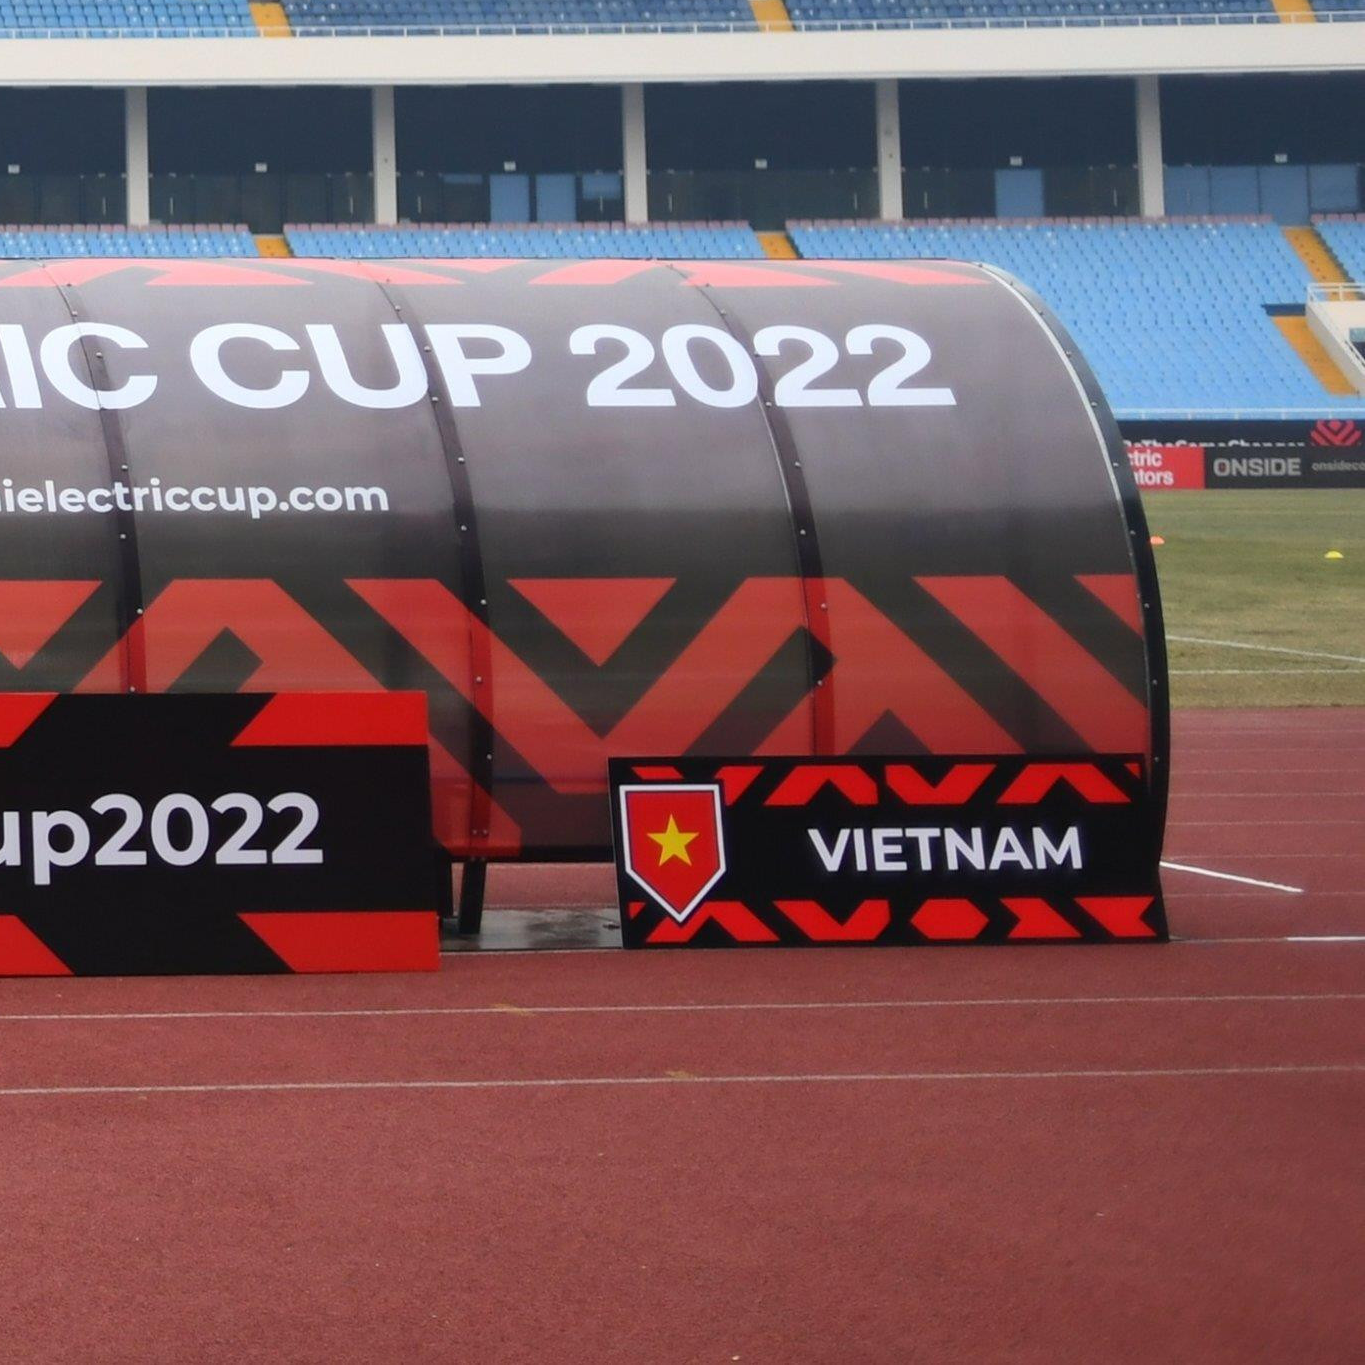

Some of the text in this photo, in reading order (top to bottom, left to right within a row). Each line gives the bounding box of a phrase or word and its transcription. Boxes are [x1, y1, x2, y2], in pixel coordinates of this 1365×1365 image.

[190, 323, 531, 408] CUP
[570, 324, 956, 407] 2022
[1128, 449, 1162, 467] tric
[1213, 458, 1302, 476] ONSIDE
[808, 826, 1082, 872] VIETNAM
